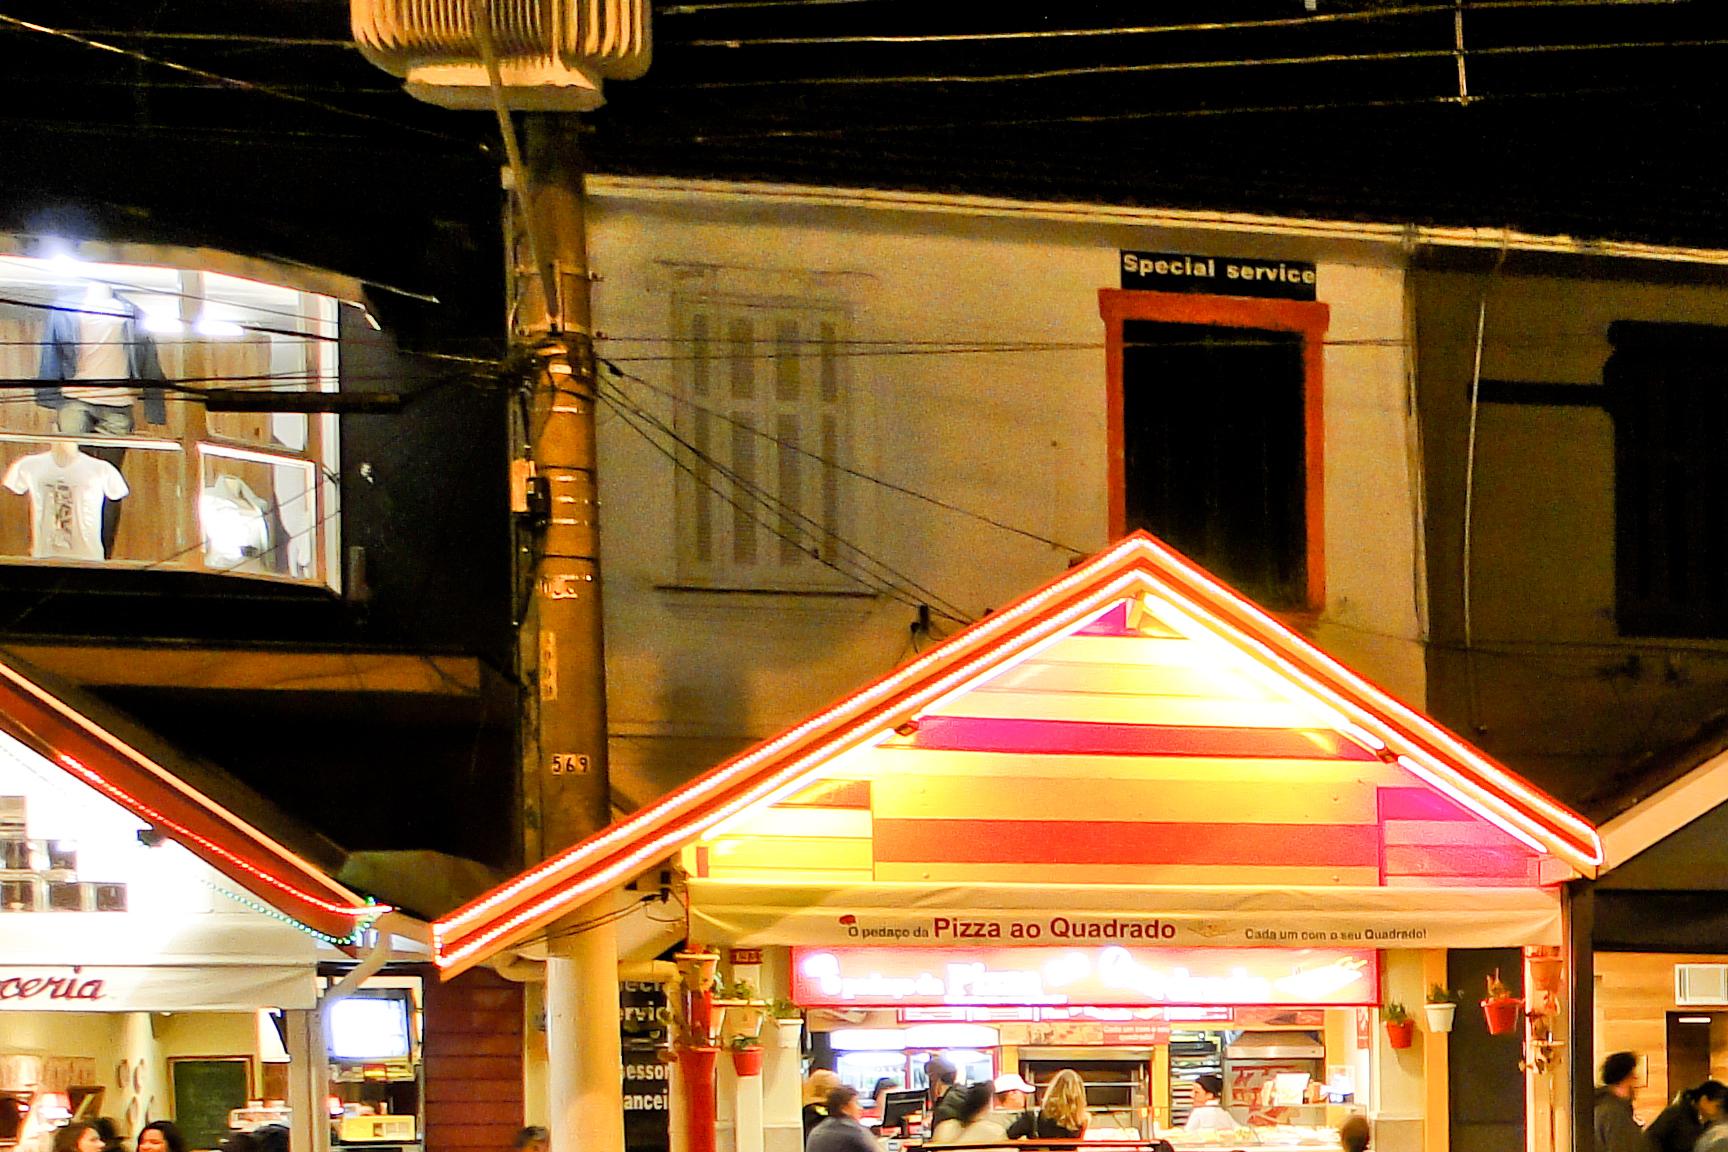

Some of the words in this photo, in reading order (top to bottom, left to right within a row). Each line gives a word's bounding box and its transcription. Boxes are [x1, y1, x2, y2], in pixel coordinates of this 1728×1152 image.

[1123, 253, 1215, 278] Special
[1226, 262, 1315, 284] service
[552, 755, 588, 773] 569
[862, 926, 911, 940] pedaço
[913, 926, 929, 938] da
[933, 917, 1001, 939] Pizza
[1010, 922, 1041, 939] ao
[1050, 917, 1176, 940] Quadrado
[1245, 928, 1276, 940] Cada
[1279, 930, 1298, 940] um
[1301, 931, 1327, 941] com
[1340, 931, 1362, 941] seu
[1364, 928, 1427, 940] Quadrado!
